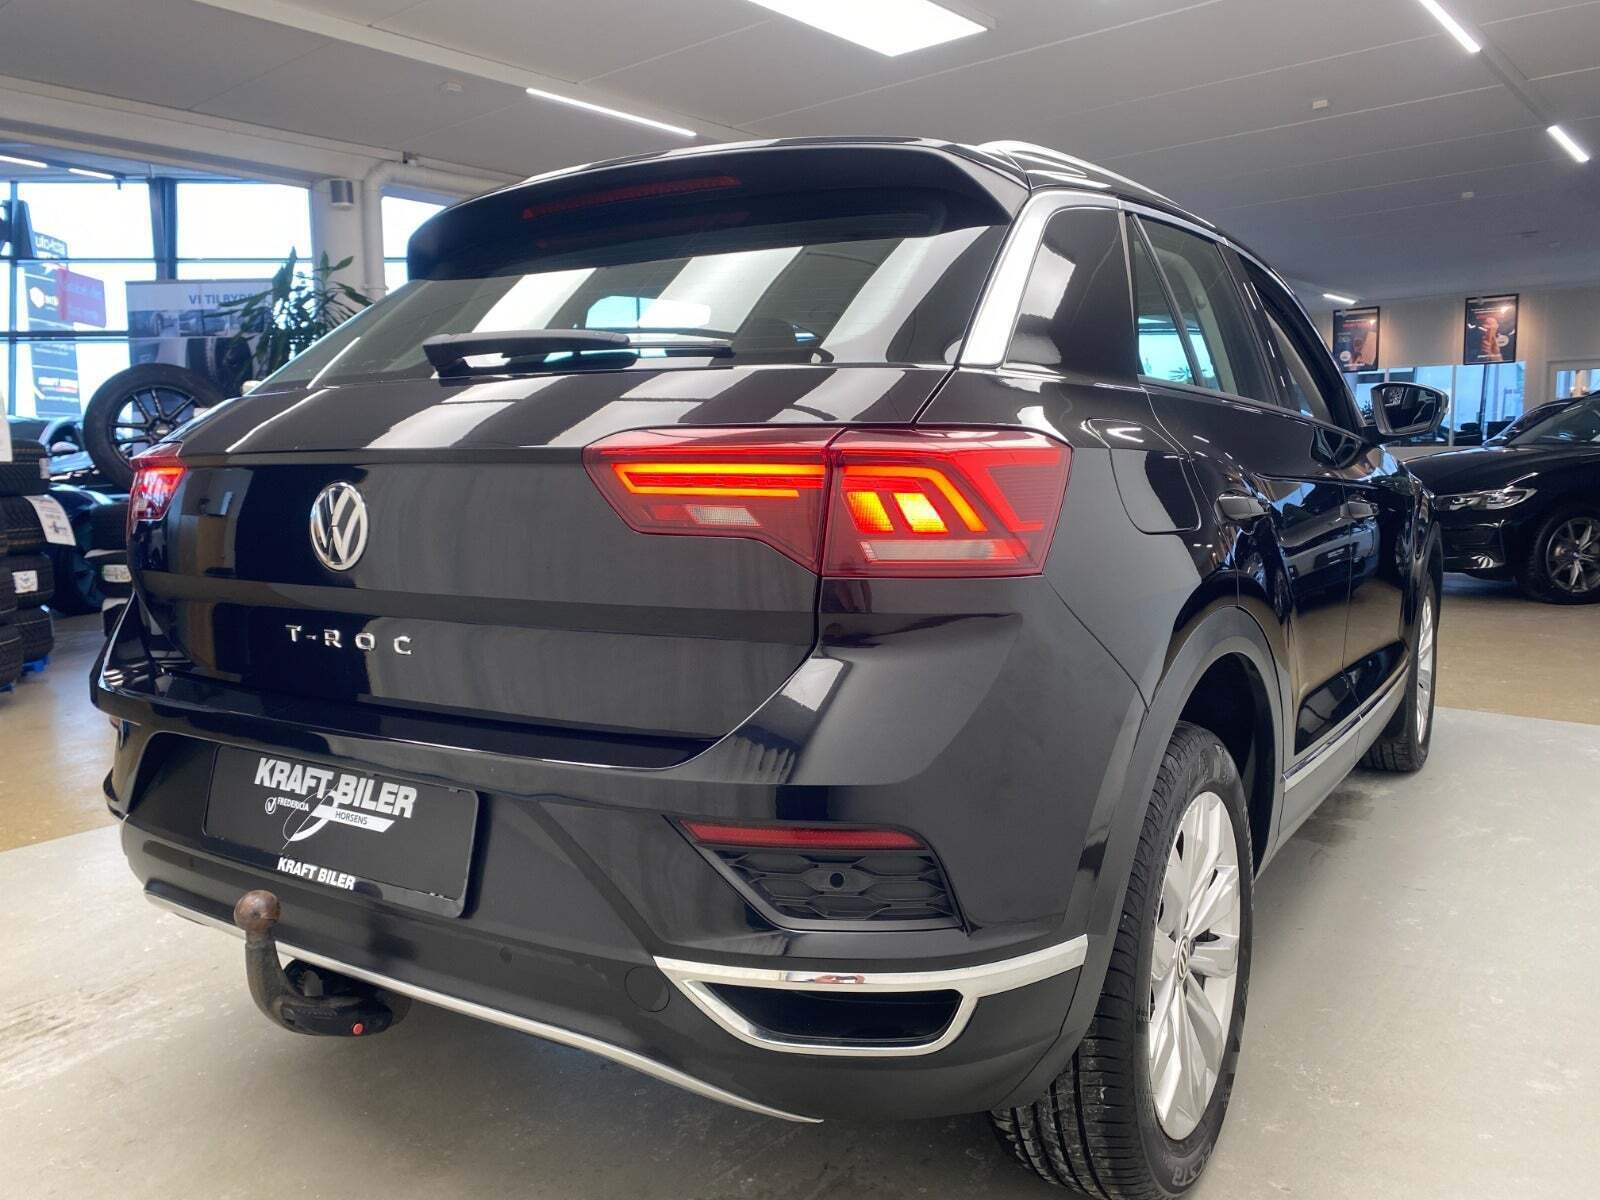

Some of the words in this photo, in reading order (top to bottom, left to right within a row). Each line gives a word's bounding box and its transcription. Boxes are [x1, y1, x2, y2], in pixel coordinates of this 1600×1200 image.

[189, 294, 200, 305] VI
[285, 624, 413, 656] T-ROC
[254, 757, 335, 799] KRAFT
[333, 773, 418, 819] BILER
[335, 810, 368, 825] HORSENS
[277, 856, 318, 880] KRAFT
[317, 867, 356, 891] BILER
